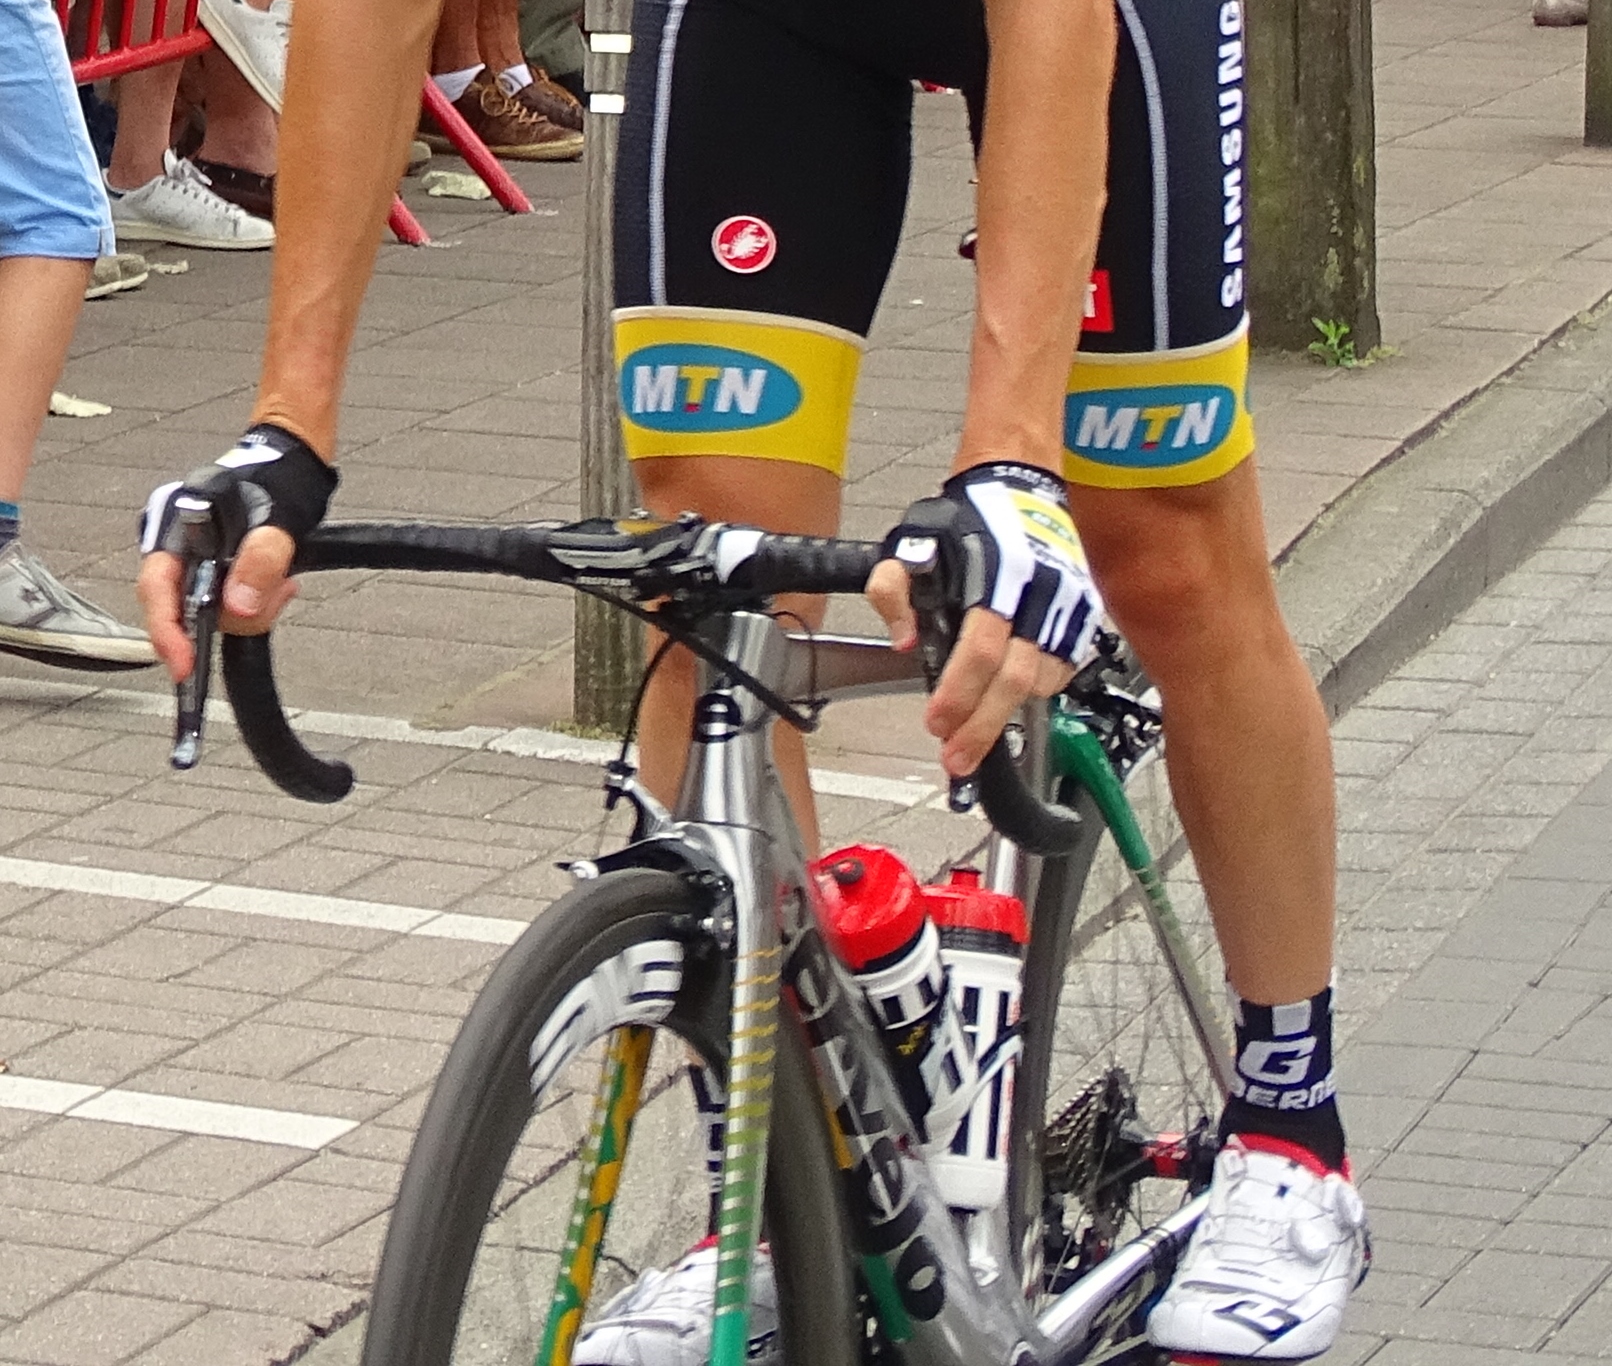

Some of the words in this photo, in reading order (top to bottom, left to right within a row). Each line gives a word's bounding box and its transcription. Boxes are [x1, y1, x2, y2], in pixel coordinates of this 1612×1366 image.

[1218, 0, 1244, 308] SAMSUNG
[632, 365, 768, 414] MTN
[1075, 396, 1220, 451] MTN
